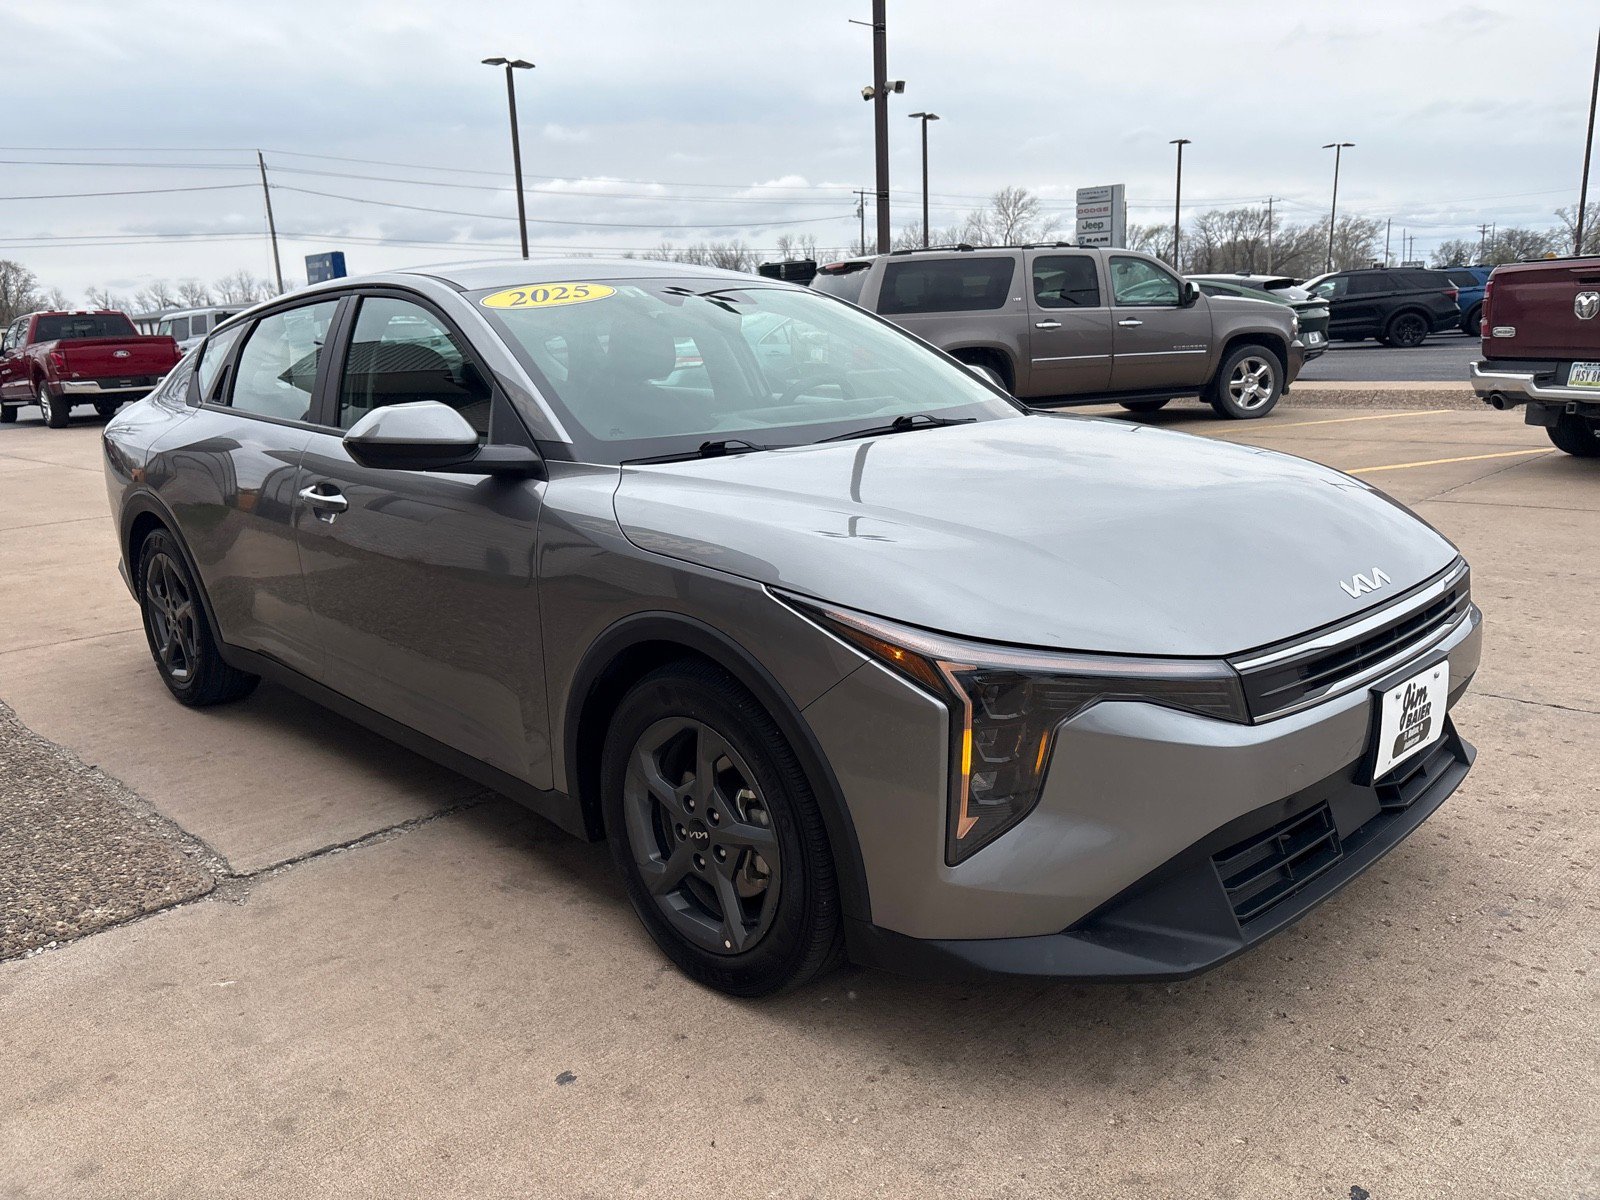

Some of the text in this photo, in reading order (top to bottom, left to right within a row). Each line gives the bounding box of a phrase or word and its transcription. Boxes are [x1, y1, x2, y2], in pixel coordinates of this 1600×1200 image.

[1077, 206, 1109, 214] DODGE
[1082, 221, 1104, 230] Jeep
[508, 285, 590, 307] 2025
[1575, 369, 1590, 382] HSY
[1399, 682, 1428, 732] Jim
[1405, 701, 1432, 730] BAIER
